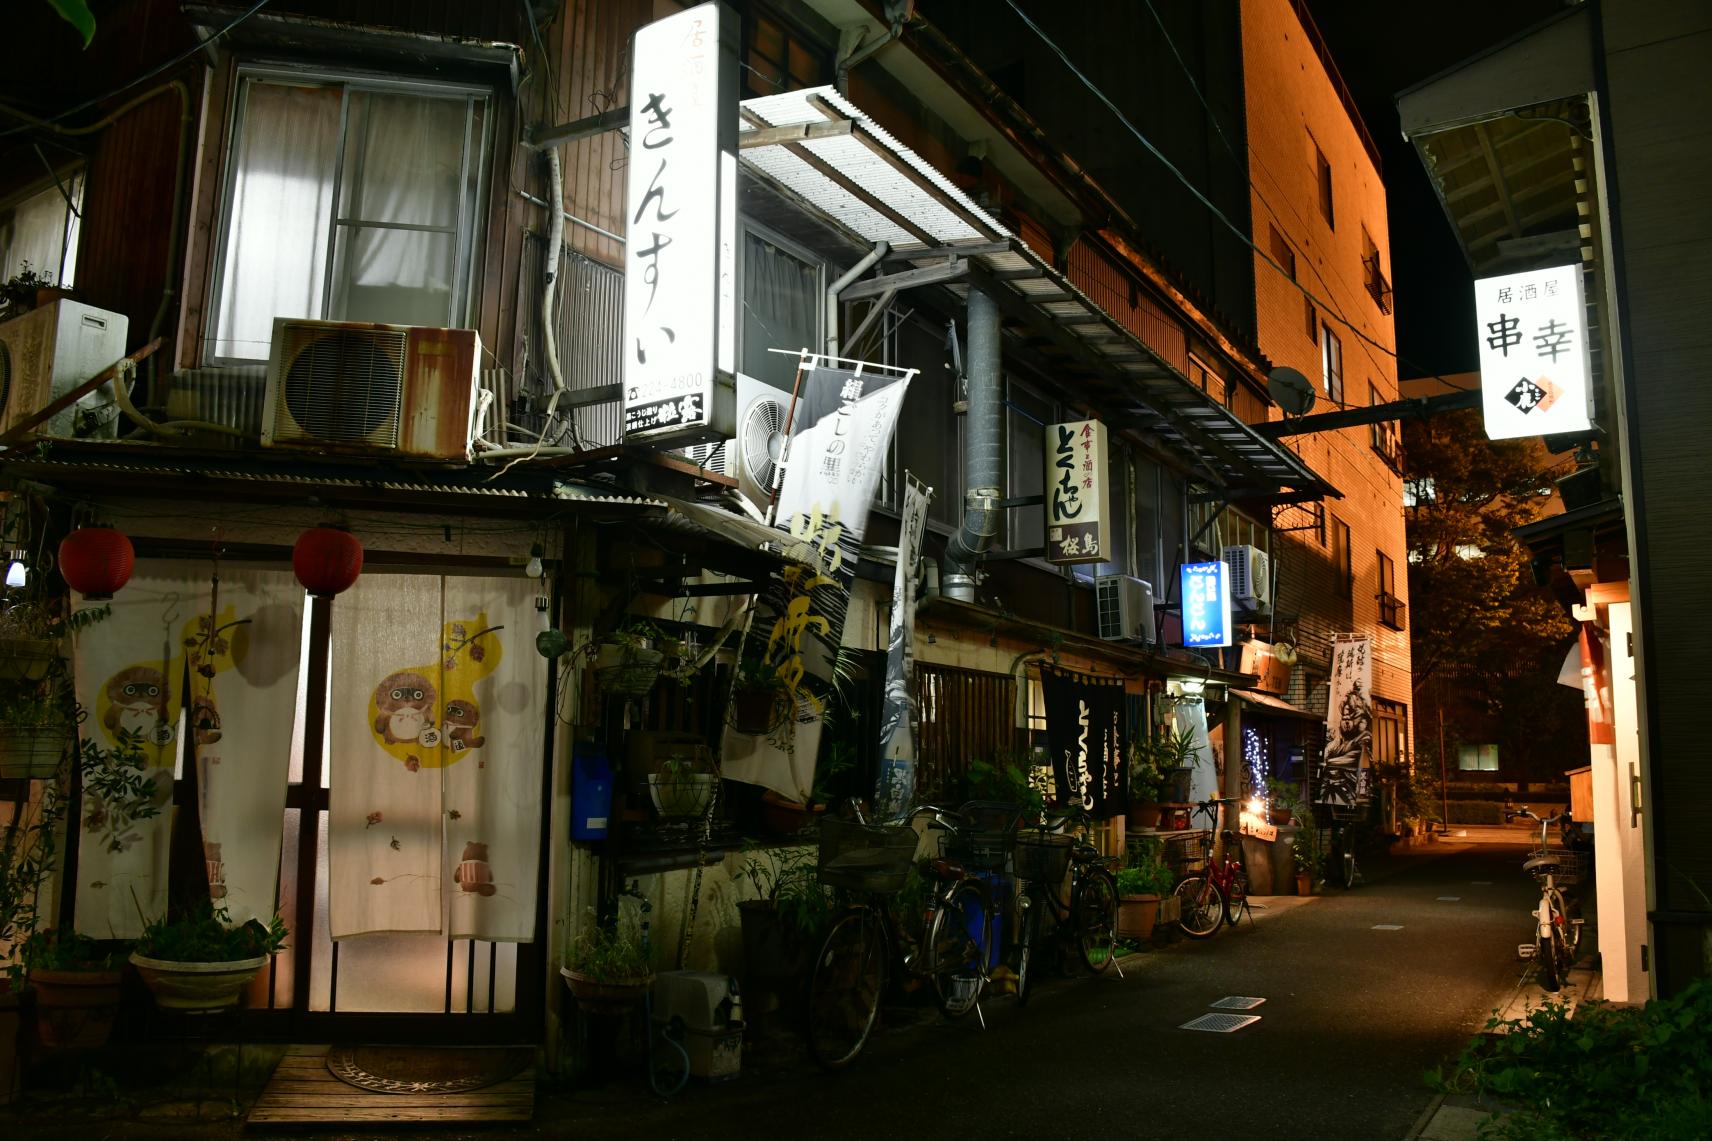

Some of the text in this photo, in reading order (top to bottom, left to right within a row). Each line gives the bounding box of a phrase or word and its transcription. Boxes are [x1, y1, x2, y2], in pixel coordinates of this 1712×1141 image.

[634, 92, 678, 365] きんすい
[1497, 279, 1560, 304] 居酒屋
[1486, 313, 1575, 365] 串幸
[1053, 424, 1083, 522] とくちゃん
[1059, 532, 1099, 557] 桜島
[1078, 699, 1094, 811] とくちゃん
